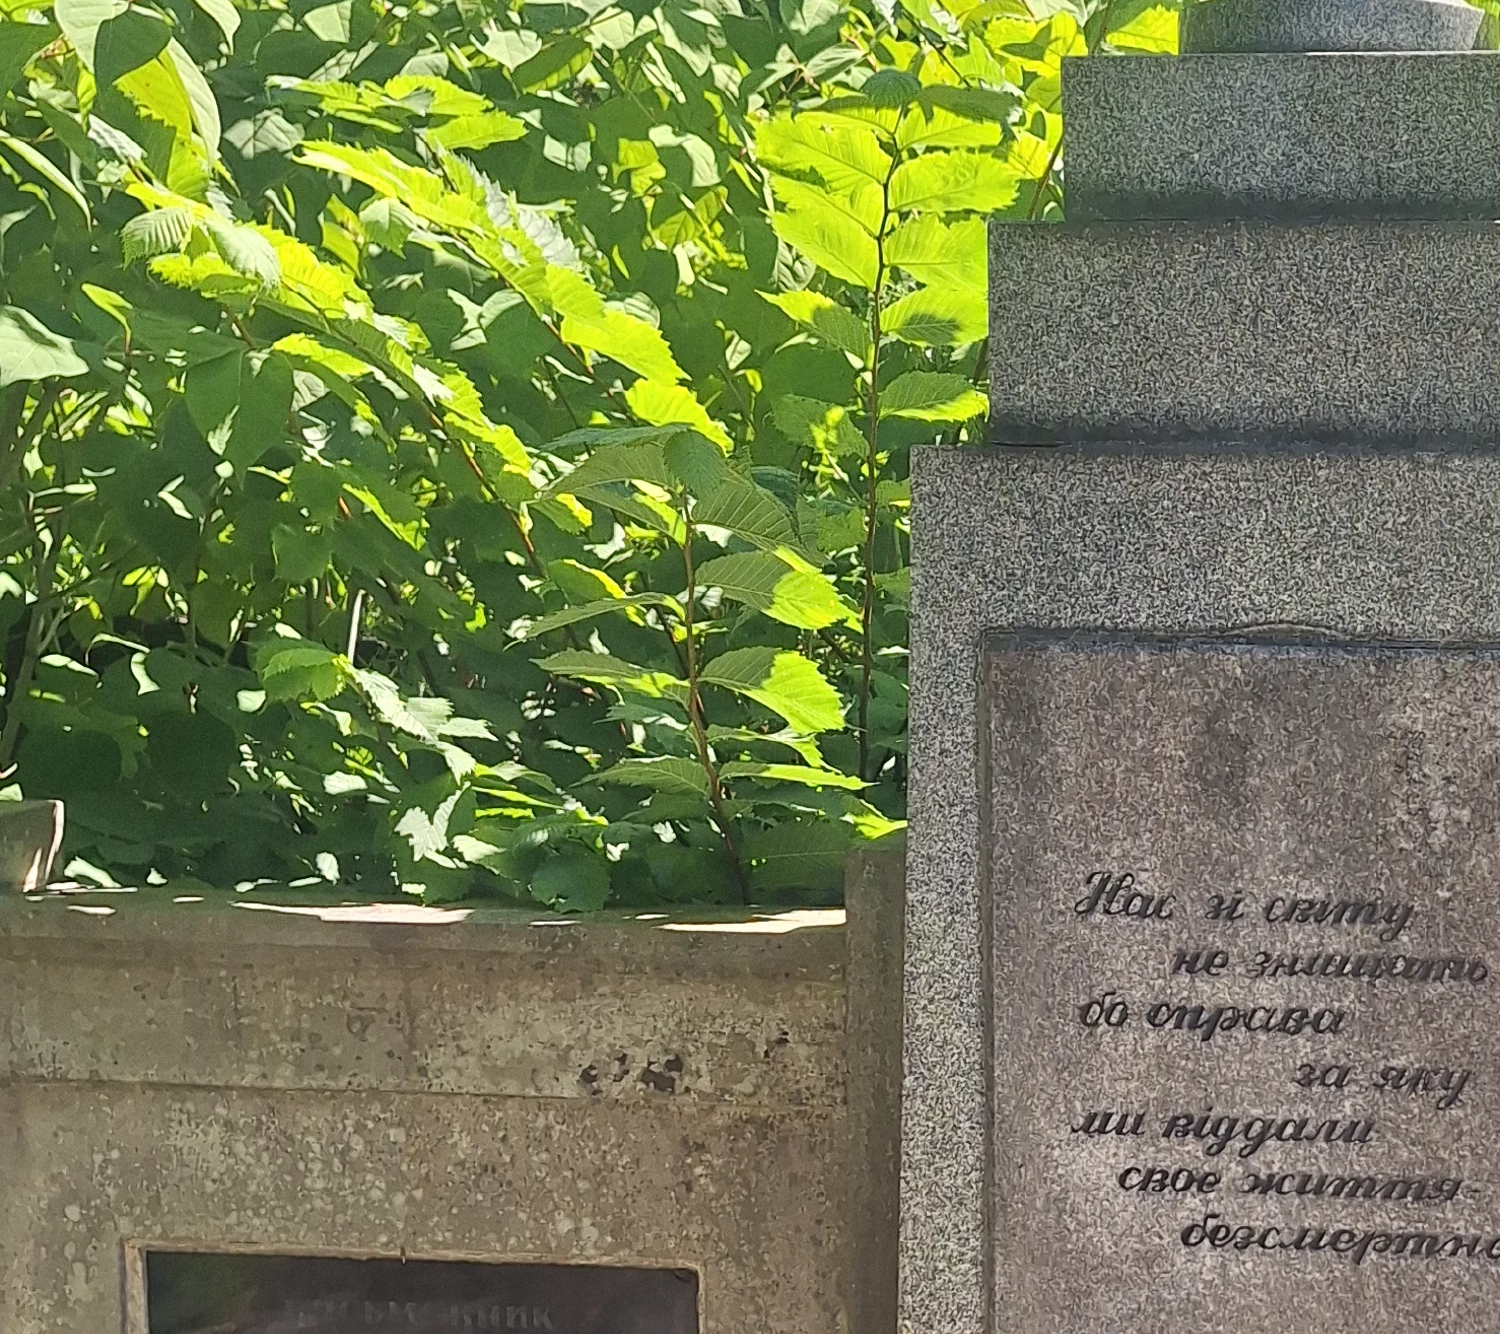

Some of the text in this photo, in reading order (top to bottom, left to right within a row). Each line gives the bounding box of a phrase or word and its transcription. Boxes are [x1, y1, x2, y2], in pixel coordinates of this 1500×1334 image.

[1074, 870, 1177, 920] Нас
[1171, 948, 1230, 978] не
[1078, 990, 1347, 1041] бо справа
[1295, 1062, 1473, 1110] за яку
[1070, 1104, 1376, 1158] ми віддали
